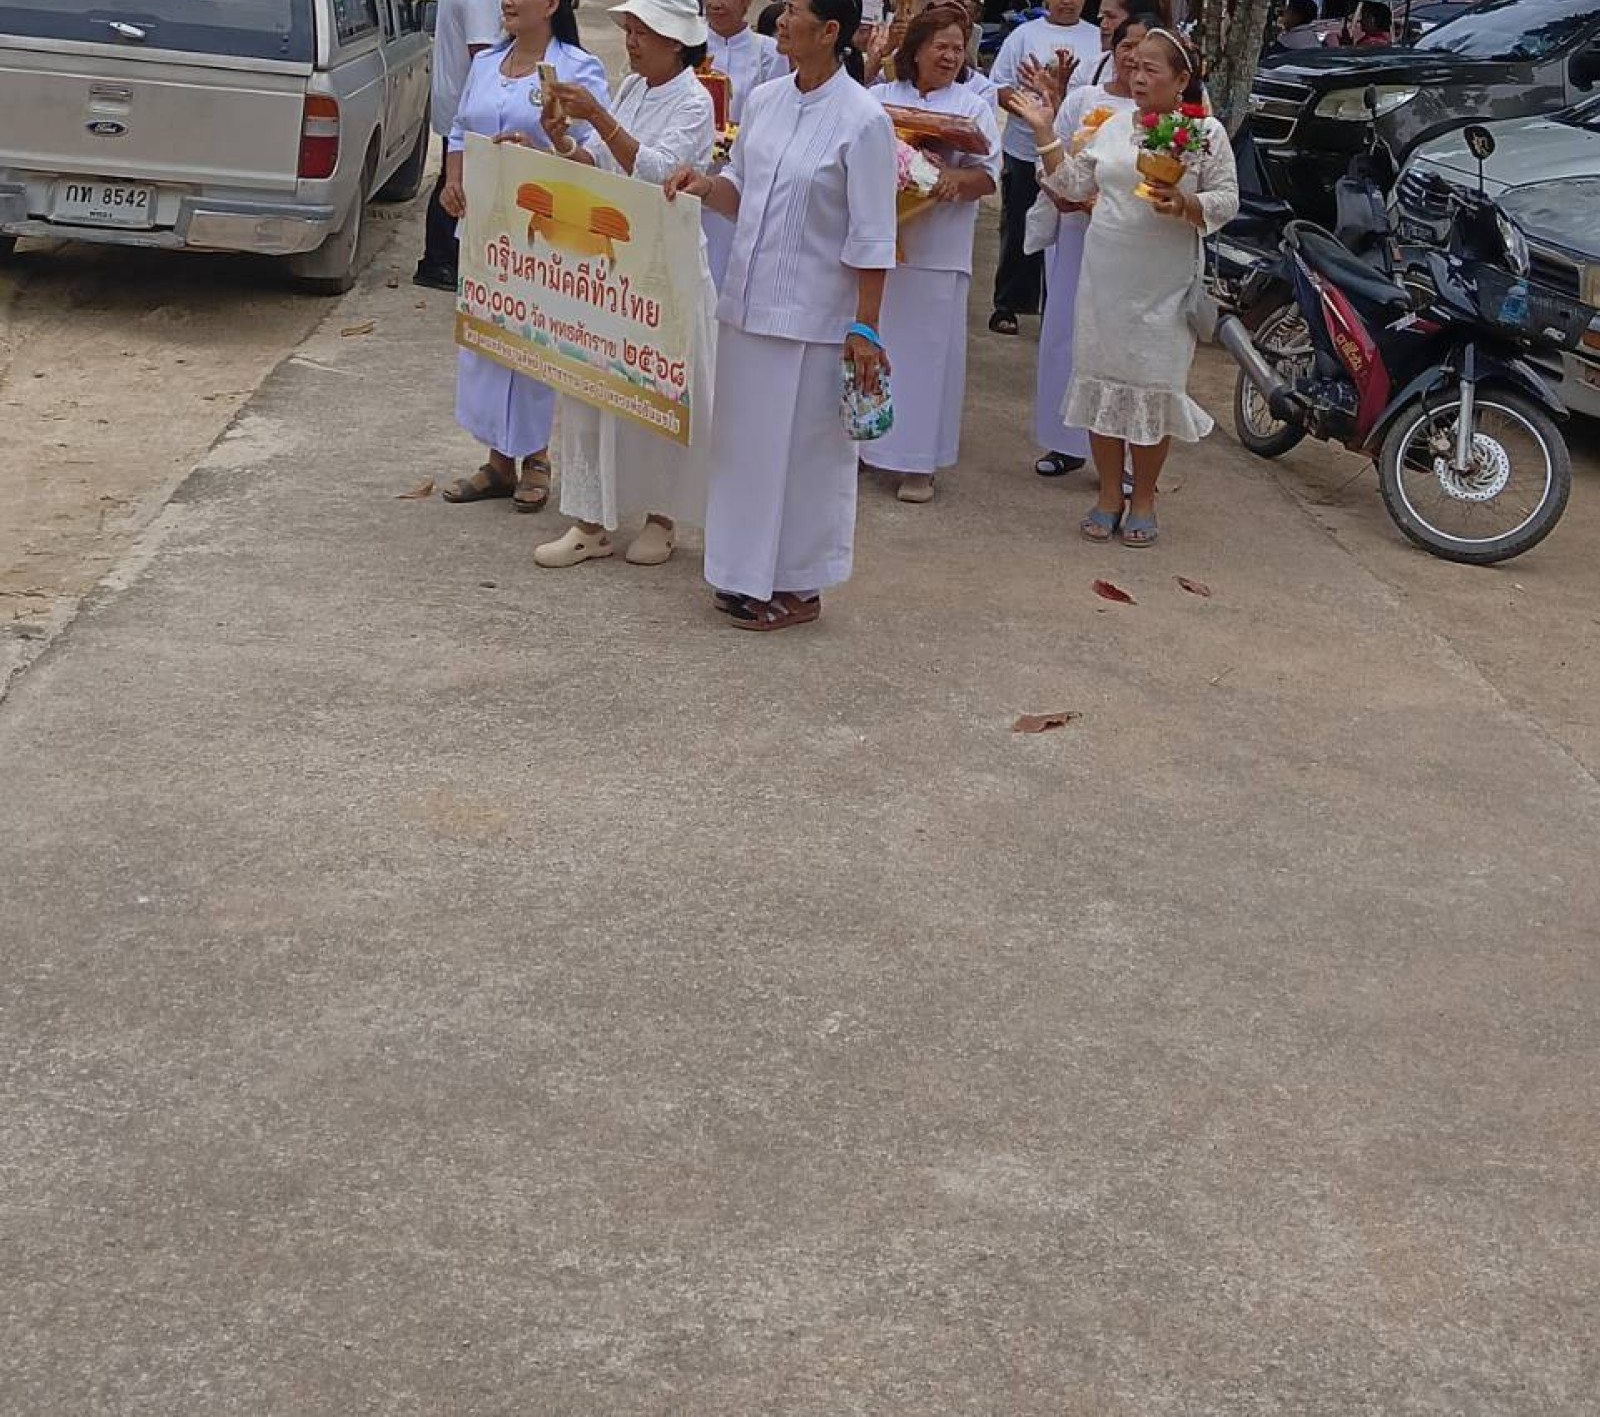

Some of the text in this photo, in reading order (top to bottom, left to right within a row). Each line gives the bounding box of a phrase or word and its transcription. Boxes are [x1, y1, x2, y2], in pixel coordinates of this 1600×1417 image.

[102, 188, 147, 208] 8542
[486, 234, 660, 328] กฐินสามัคคีทั่วไทย
[531, 302, 546, 329] วัด
[549, 318, 617, 359] พุทธศักราช
[623, 336, 685, 388] ๒๕๖๘
